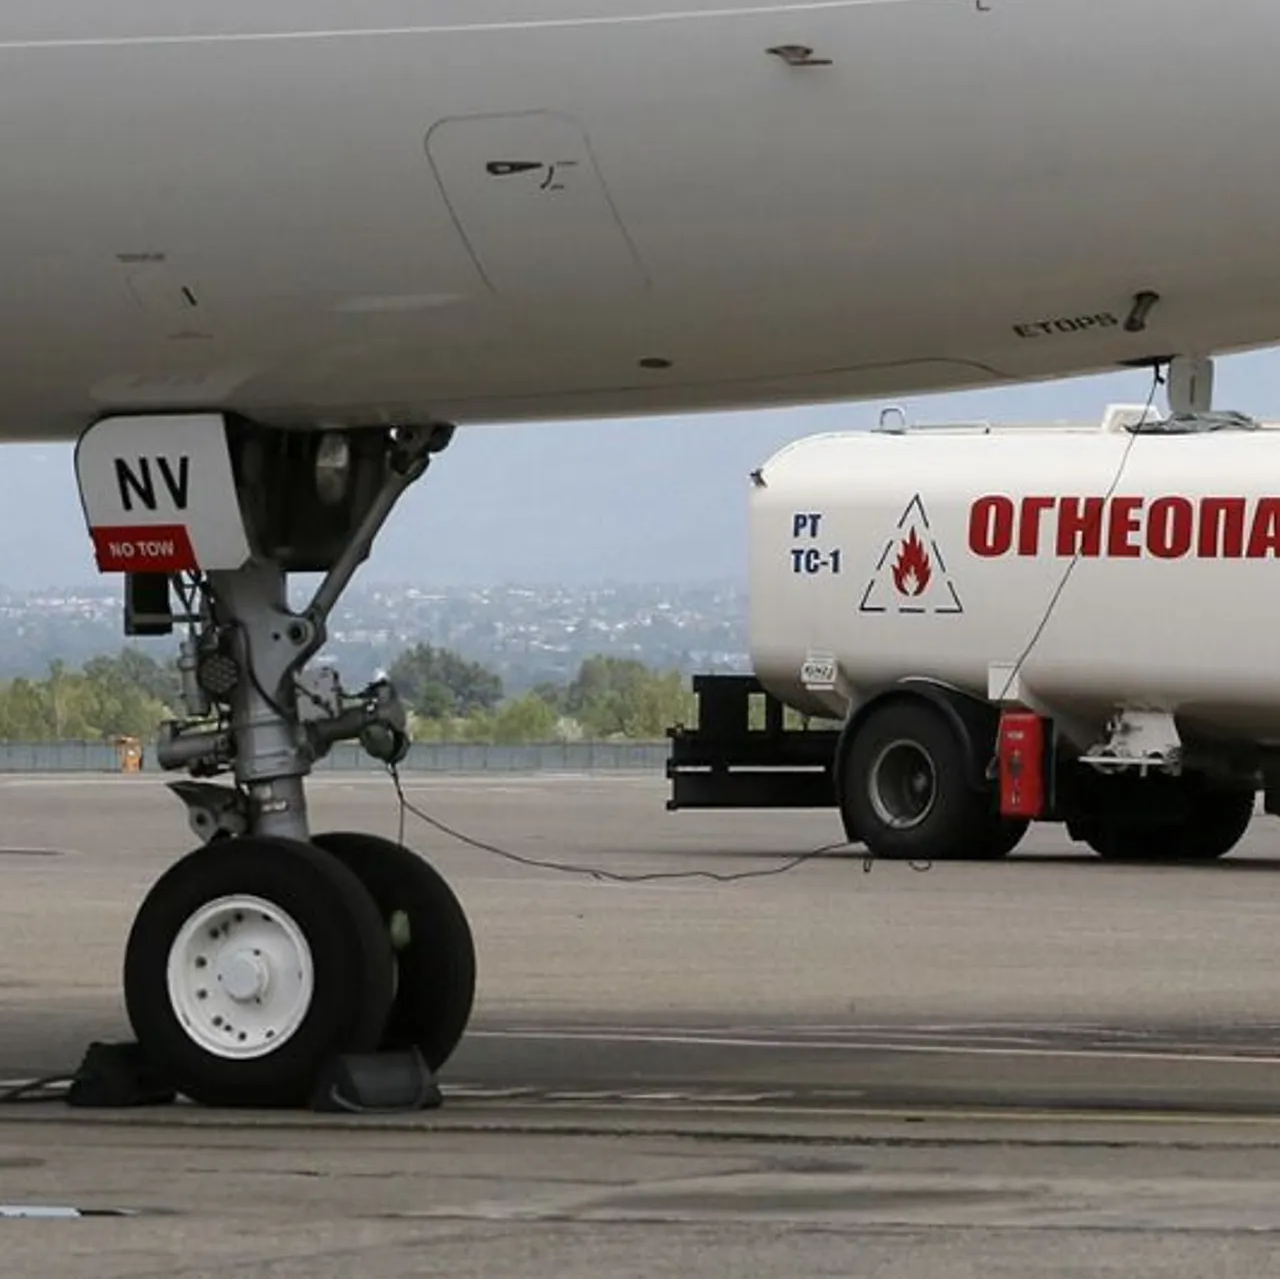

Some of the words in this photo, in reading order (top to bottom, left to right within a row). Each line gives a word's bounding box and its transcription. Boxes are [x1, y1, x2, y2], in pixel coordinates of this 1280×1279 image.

[1012, 312, 1119, 338] ETOPS
[115, 456, 189, 511] NV
[108, 542, 134, 558] NO
[138, 540, 176, 557] TOW
